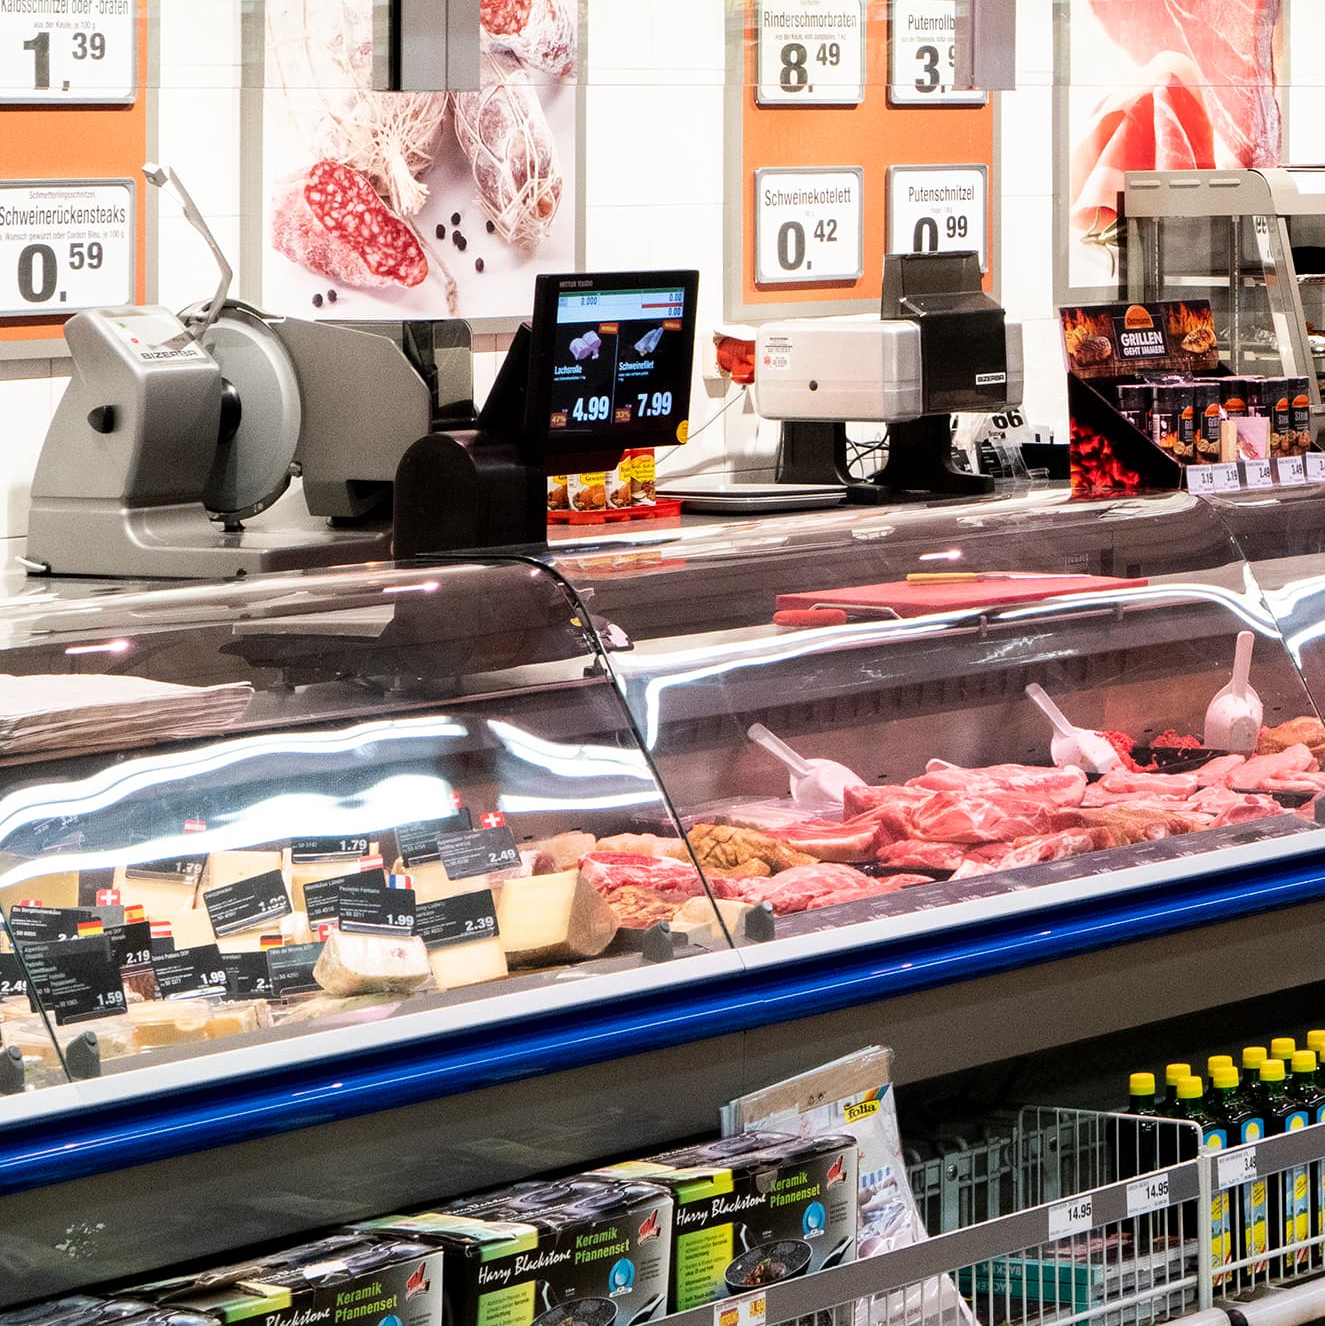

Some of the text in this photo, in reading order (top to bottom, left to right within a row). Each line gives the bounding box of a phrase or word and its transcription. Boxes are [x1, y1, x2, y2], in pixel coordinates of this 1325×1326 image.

[763, 11, 857, 28] Rinderschmorbraten
[764, 187, 851, 207] Schweinekotelett
[908, 185, 975, 203] Putenschnitzel
[0, 205, 126, 226] Schweinerückensteaks
[1120, 331, 1164, 347] GRILLEN
[140, 349, 199, 360] BIZERBA
[1123, 343, 1165, 355] GEHT IMMER!
[554, 360, 655, 375] Lachsrolle Schweinefilet
[572, 391, 673, 422] 4.99 7.99
[339, 839, 368, 851] 1.79
[488, 849, 516, 863] 2.49
[386, 914, 415, 926] 1.99
[464, 916, 495, 932] 2.39
[126, 949, 151, 964] 2.19
[200, 970, 226, 985] 1.99
[96, 990, 124, 1006] 1.59
[848, 1103, 877, 1119] folia
[770, 1172, 809, 1192] Keramik
[1146, 1181, 1169, 1200] 14.95
[770, 1184, 821, 1209] Pfannenset
[676, 1193, 767, 1227] Harry Blackstone
[1068, 1203, 1092, 1222] 14.95
[575, 1227, 618, 1249] Keramik
[574, 1239, 631, 1266] Pfannenset
[478, 1248, 572, 1286] Harry Blackstone
[336, 1281, 382, 1307] Keramik
[334, 1294, 399, 1324] Pfannenset
